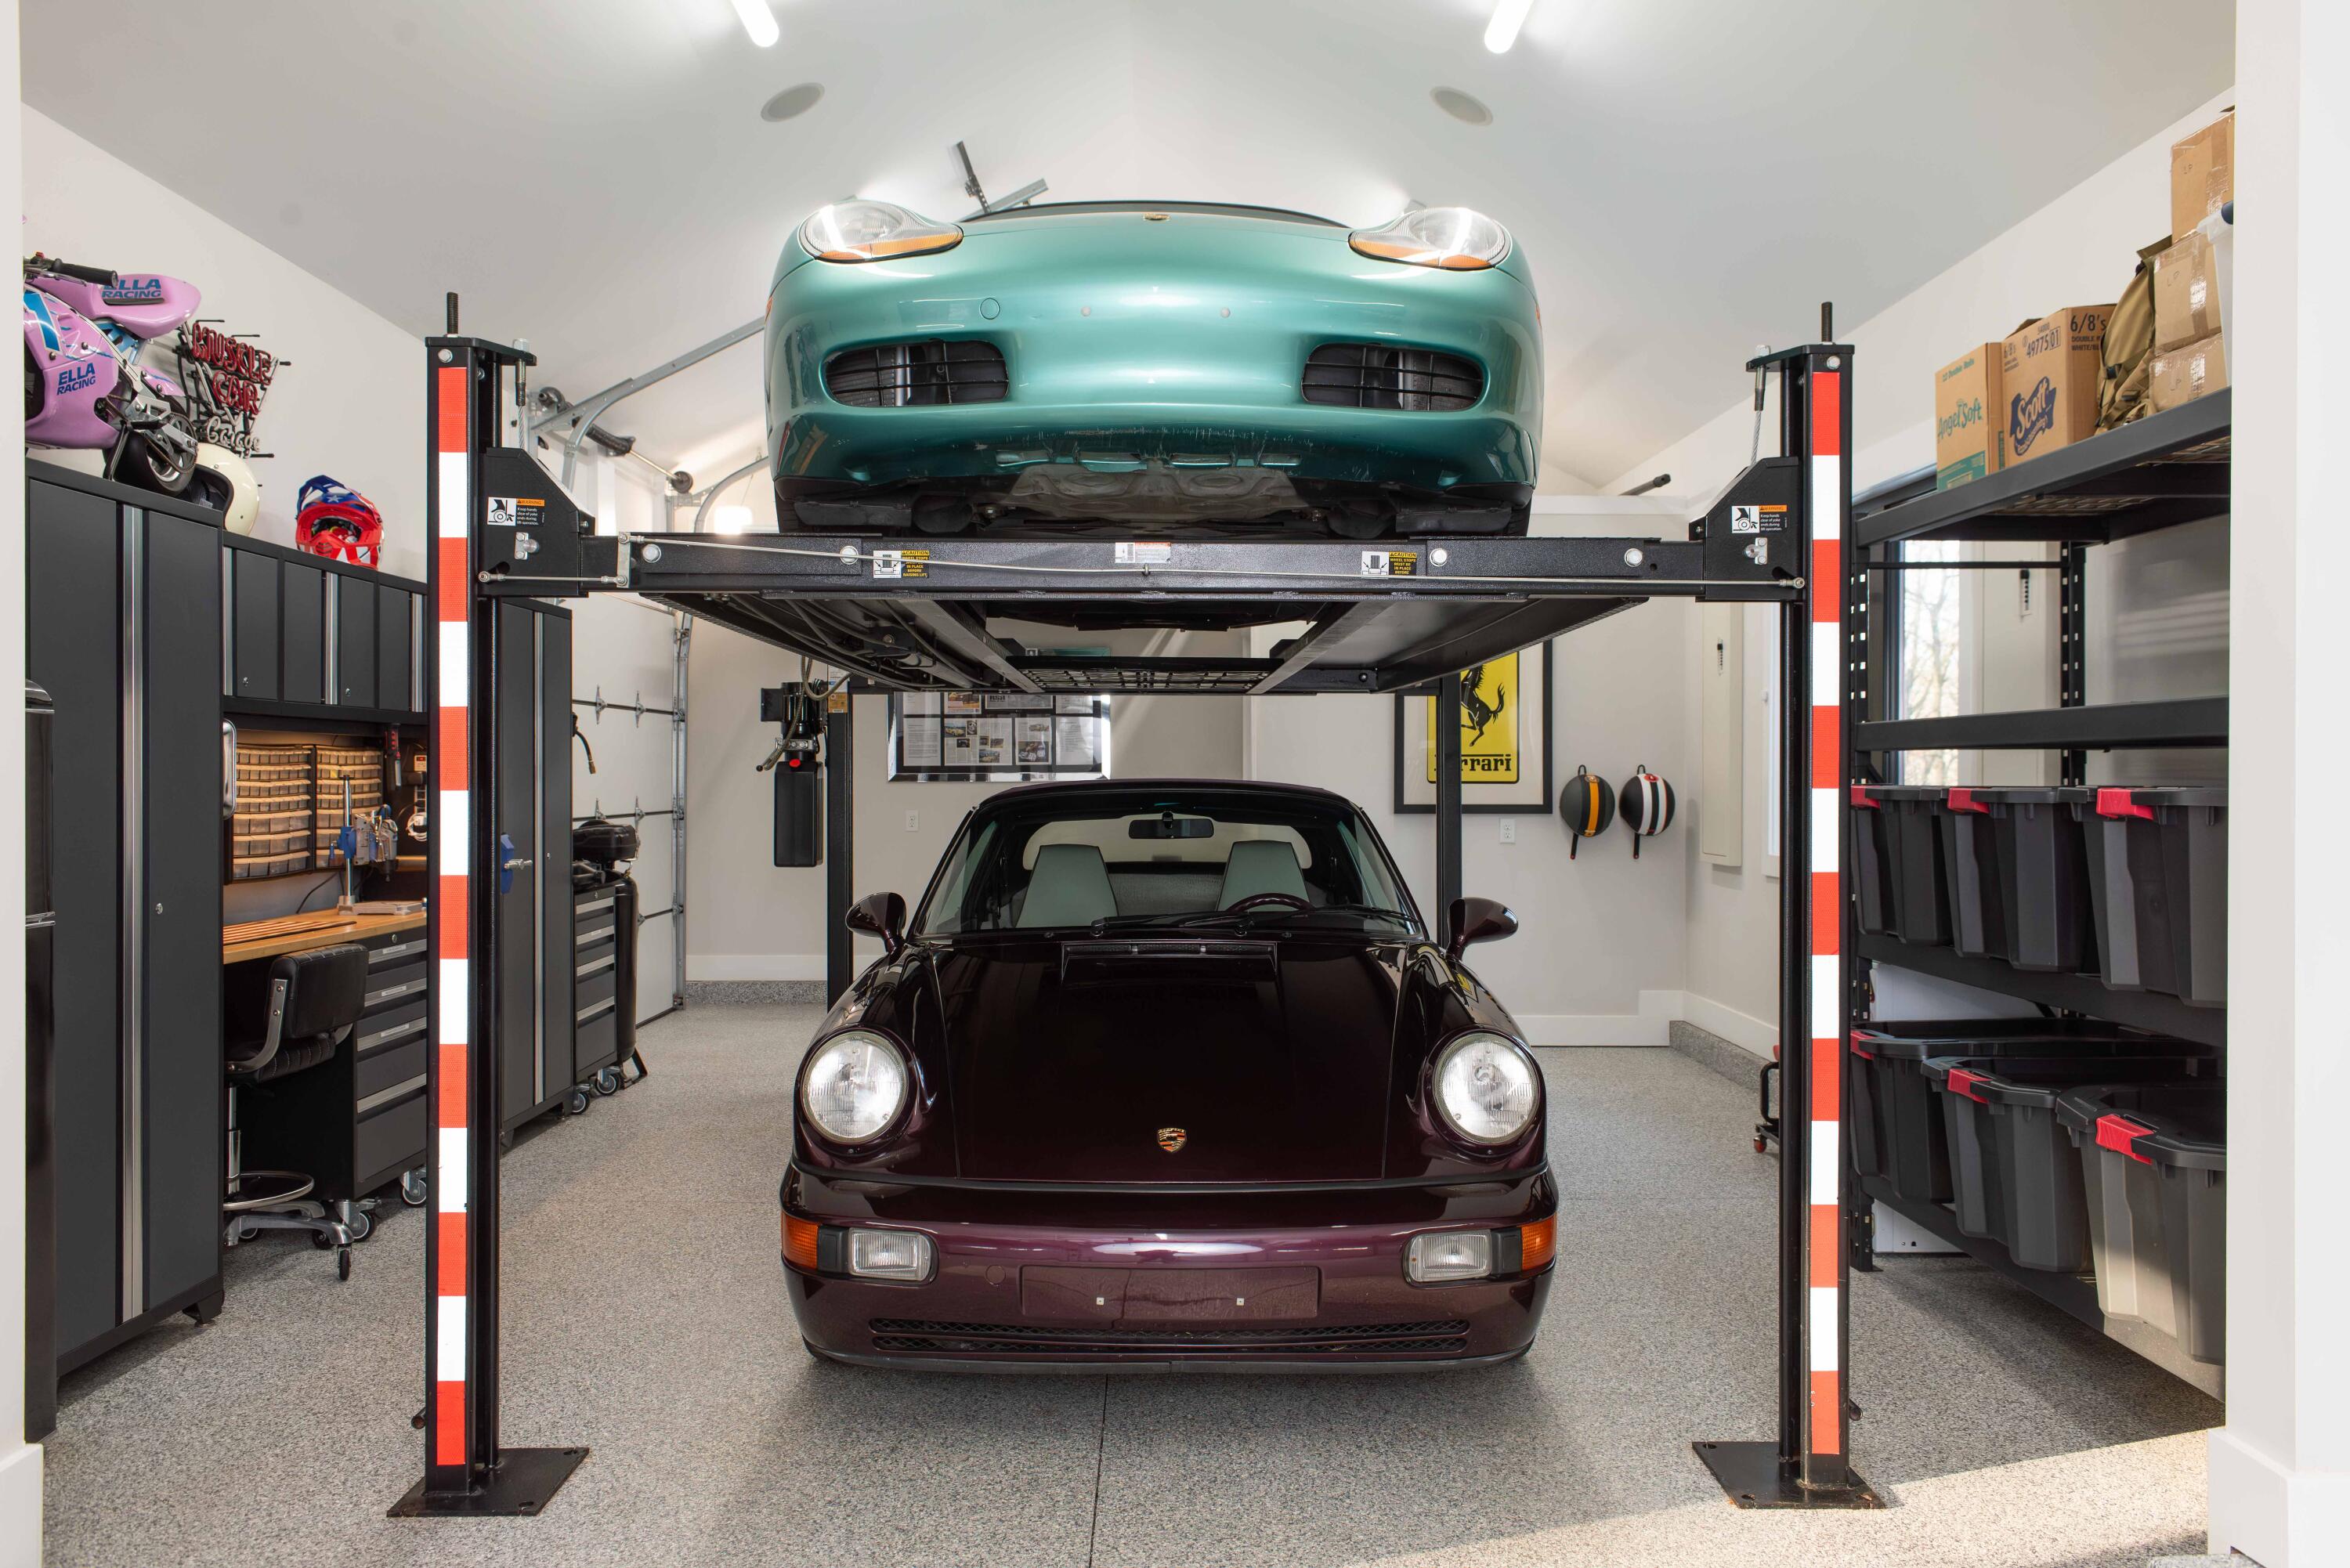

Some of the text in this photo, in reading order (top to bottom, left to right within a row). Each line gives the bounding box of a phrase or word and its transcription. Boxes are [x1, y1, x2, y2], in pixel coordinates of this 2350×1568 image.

[101, 290, 161, 298] RACING
[191, 321, 272, 386] MUSCLE
[2026, 333, 2049, 359] 49775
[56, 375, 96, 396] RACING
[58, 363, 96, 385] ELLA
[212, 370, 259, 415] CAR
[1937, 397, 1983, 439] Angel Soft
[2016, 377, 2048, 441] Scott
[1434, 754, 1512, 771] rrari
